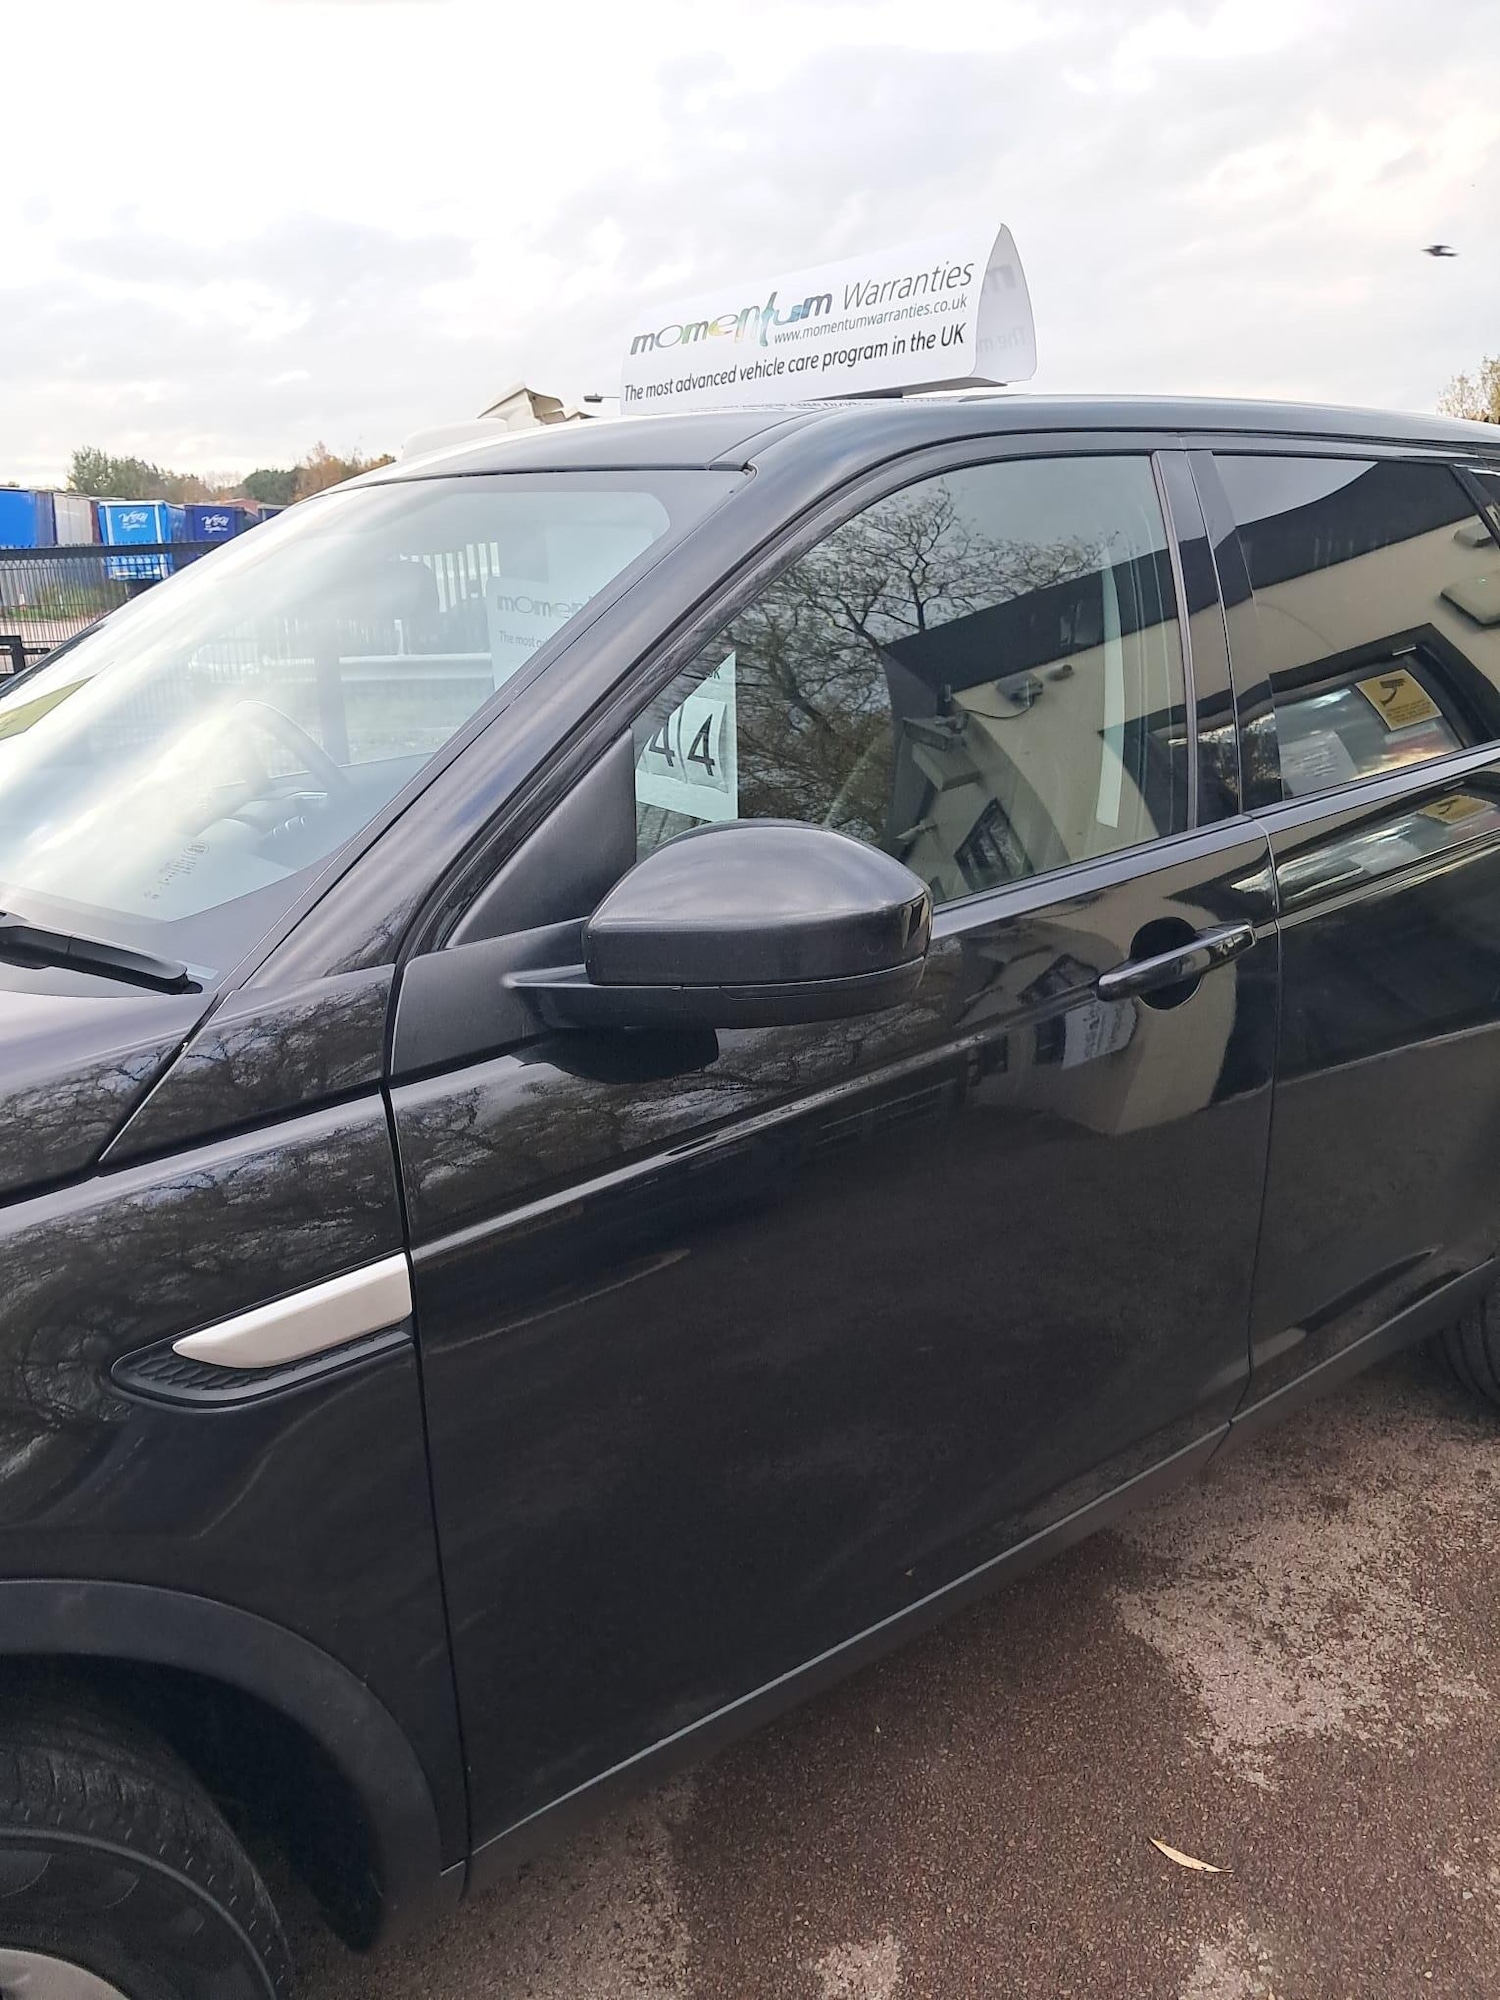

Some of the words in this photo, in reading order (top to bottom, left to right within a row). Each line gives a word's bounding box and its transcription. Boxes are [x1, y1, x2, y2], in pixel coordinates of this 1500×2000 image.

[630, 291, 833, 355] momentum
[843, 261, 975, 310] Warranties
[774, 293, 968, 344] www.momentumwarranties.co.uk
[624, 384, 643, 402] The
[645, 378, 674, 399] most
[675, 365, 737, 393] advanced
[740, 357, 785, 381] vehicle
[788, 354, 820, 373] care
[822, 340, 889, 373] program
[892, 335, 906, 355] in
[910, 330, 936, 352] the
[941, 322, 967, 347] UK
